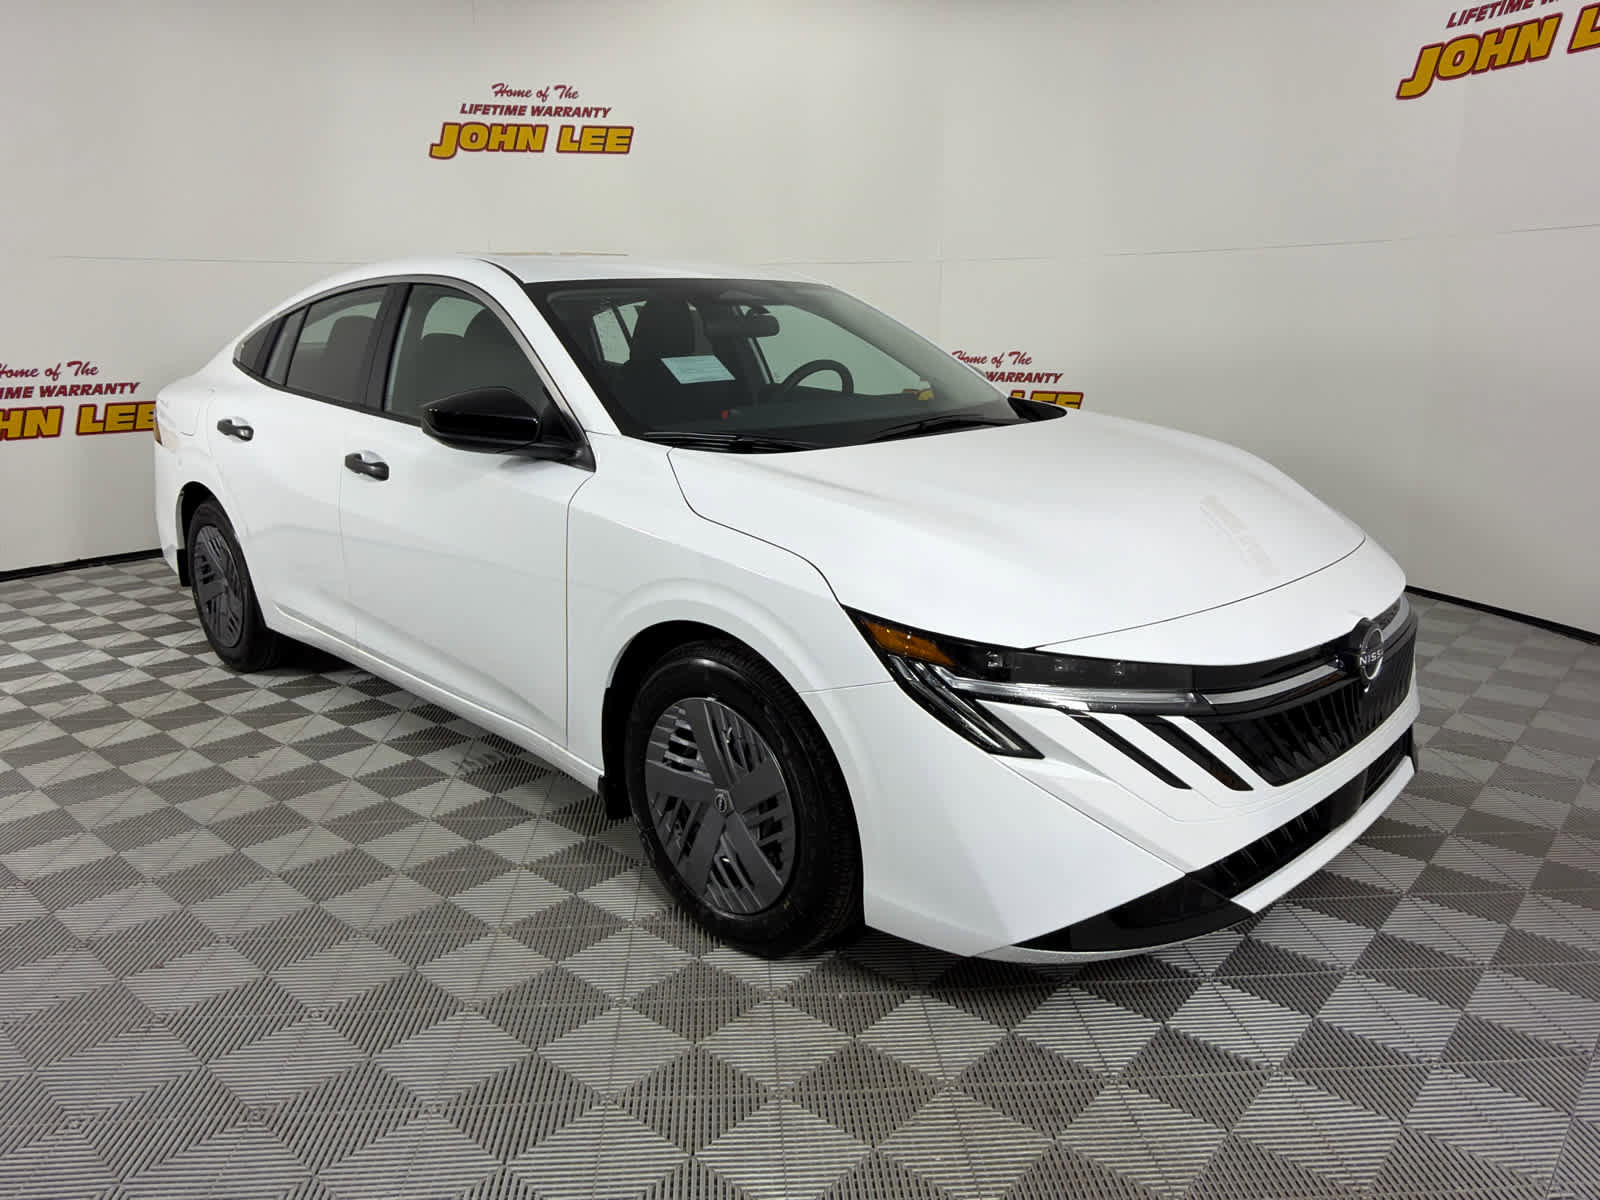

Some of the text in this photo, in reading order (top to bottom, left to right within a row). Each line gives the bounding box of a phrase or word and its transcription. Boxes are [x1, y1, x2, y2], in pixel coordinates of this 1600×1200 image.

[1446, 0, 1534, 28] LIFETIME
[1396, 12, 1563, 100] JOHN
[491, 82, 580, 102] Home of The
[460, 104, 611, 118] LIFETIME WARRANTY
[429, 122, 634, 159] JOHN LEE
[991, 352, 1005, 368] of
[1008, 351, 1033, 365] The
[44, 362, 61, 381] of
[66, 361, 99, 376] The
[985, 371, 1063, 384] WARRANTY
[40, 382, 140, 398] WARRANTY
[76, 401, 156, 436] LEE
